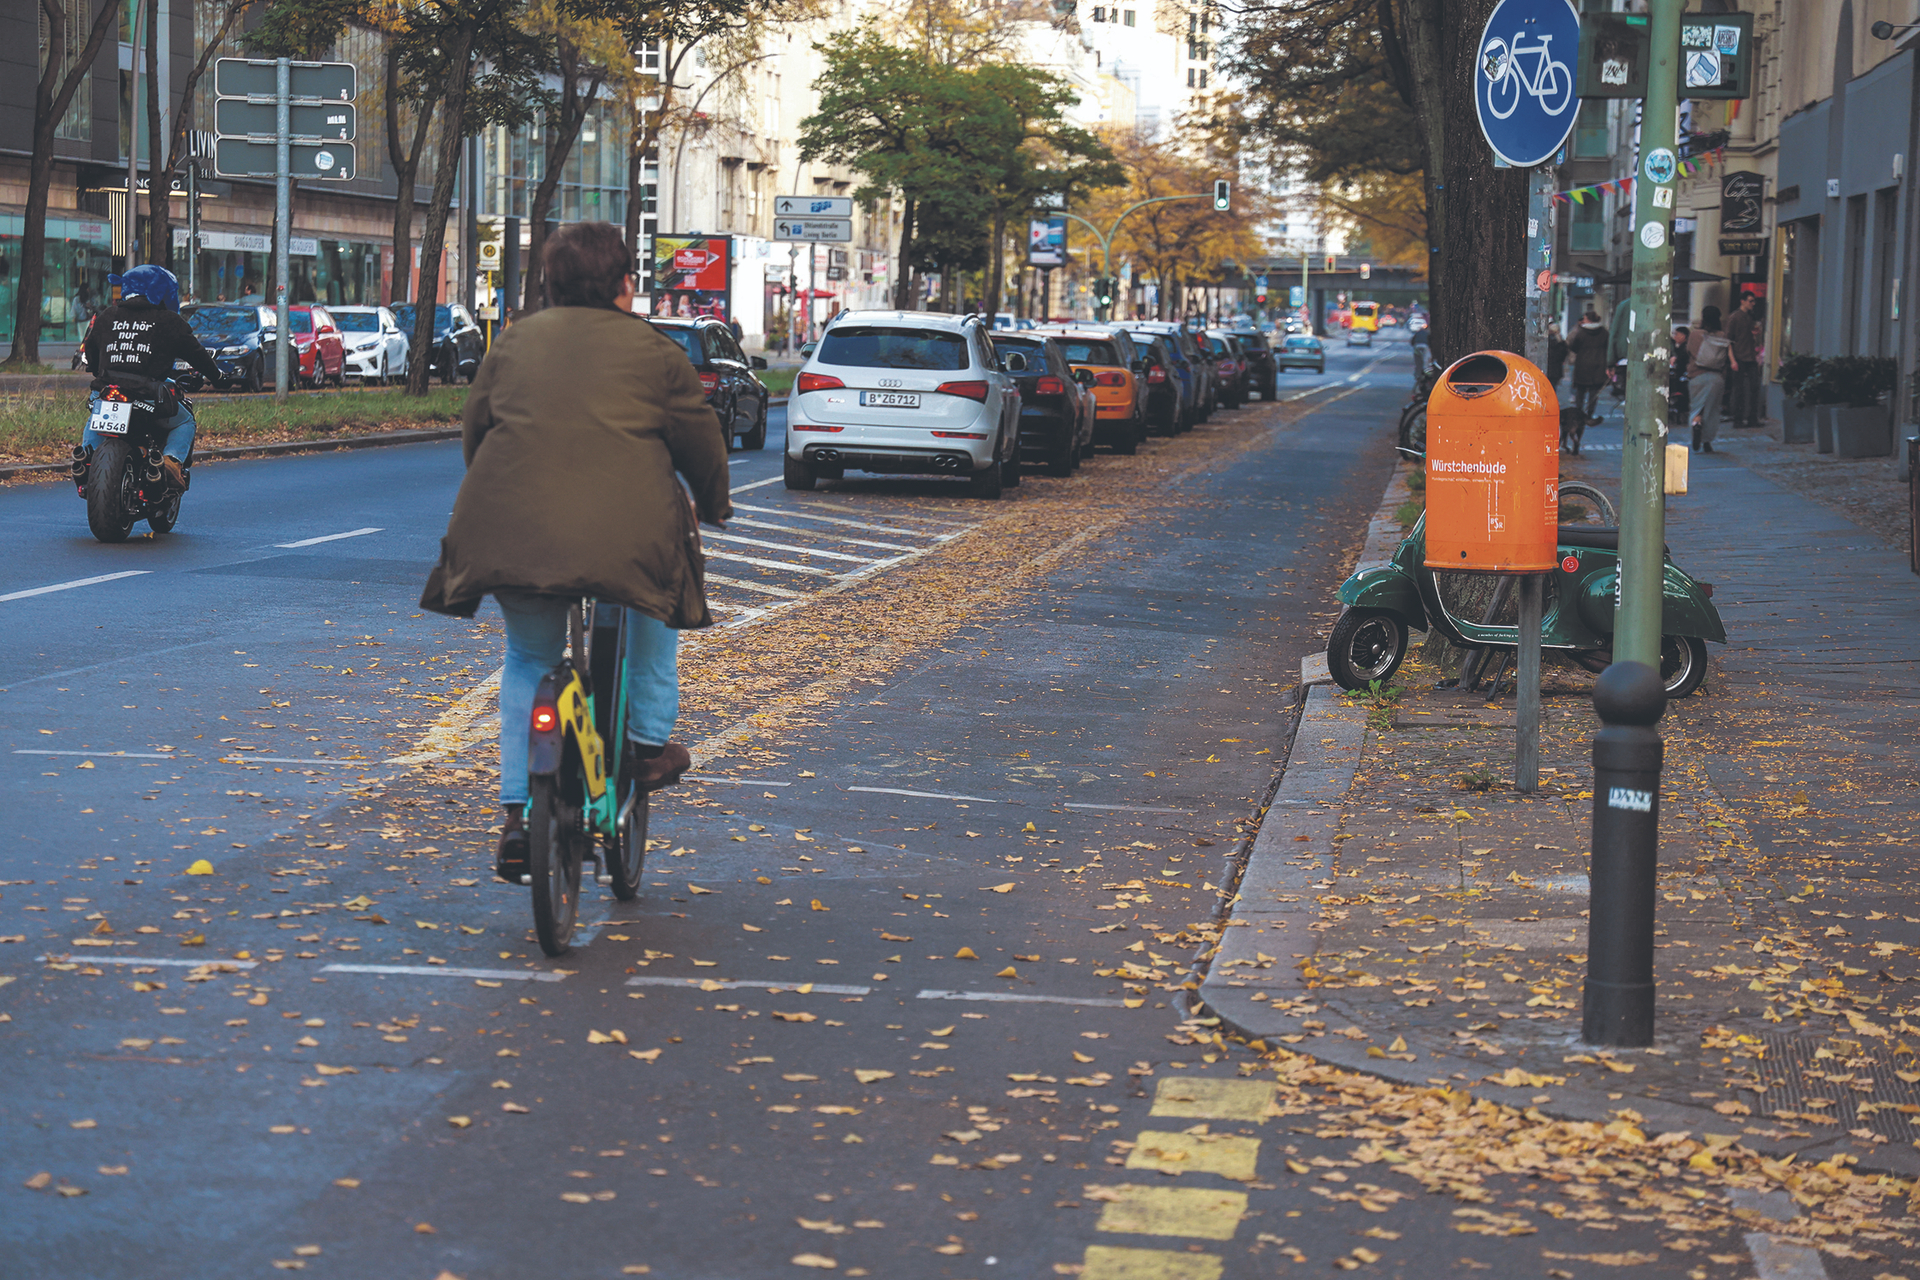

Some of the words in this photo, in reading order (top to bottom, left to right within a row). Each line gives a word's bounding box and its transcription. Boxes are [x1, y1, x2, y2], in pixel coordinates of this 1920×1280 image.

[190, 129, 217, 159] LIVIN
[112, 320, 130, 331] Ich
[118, 331, 139, 340] nur
[869, 393, 877, 404] B
[112, 403, 119, 412] B
[1431, 459, 1507, 474] Würstchenbude
